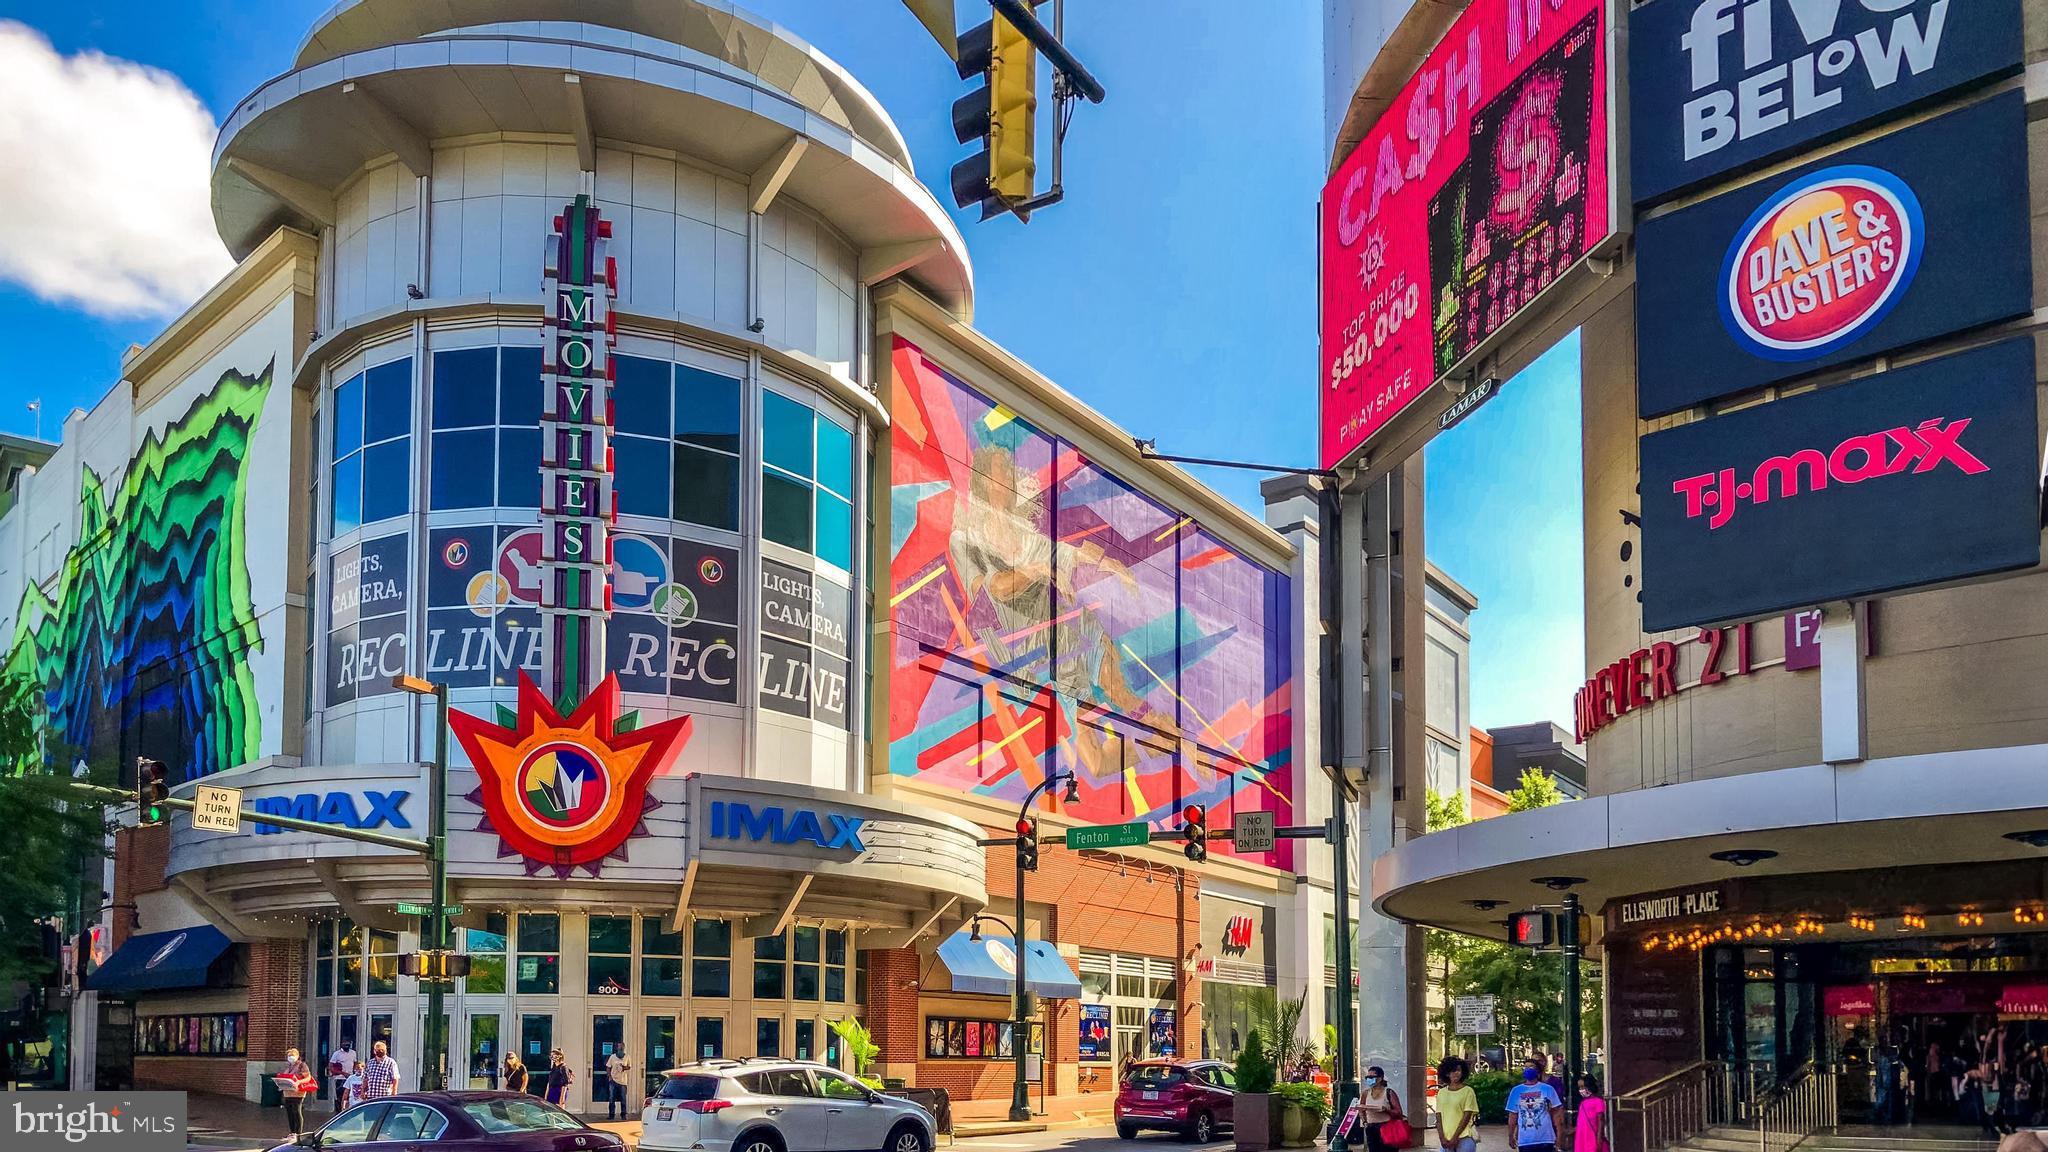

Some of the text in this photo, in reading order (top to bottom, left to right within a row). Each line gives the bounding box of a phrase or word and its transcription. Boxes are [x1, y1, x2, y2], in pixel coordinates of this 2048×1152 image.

[1681, 0, 1911, 92] fiv
[1683, 1, 1950, 161] BELOW
[1750, 200, 1891, 293] DAVE &
[1752, 236, 1894, 327] BUSTER'S
[1343, 272, 1405, 344] TOP PRIZE
[1332, 283, 1419, 390] $50,000
[1376, 368, 1411, 412] SAFE
[1442, 384, 1486, 425] LAMAR
[560, 294, 594, 556] MOVIES
[336, 554, 383, 584] LIGHTS,
[332, 579, 402, 614] CAMERA,
[763, 571, 824, 609] LIGHTS,
[765, 600, 847, 648] CAMERA,
[1699, 622, 1752, 685] 21
[205, 803, 231, 814] TURN
[211, 792, 228, 802] NO
[255, 791, 412, 835] IMAX
[198, 814, 235, 827] ON RED
[711, 801, 866, 853] IMAX
[1076, 825, 1132, 845] Fenton St
[1242, 824, 1266, 836] TURN
[1246, 816, 1262, 825] NO
[1238, 838, 1271, 848] ON RED
[1622, 890, 1720, 922] ELLSWORTH PLACE
[598, 986, 618, 994] 900
